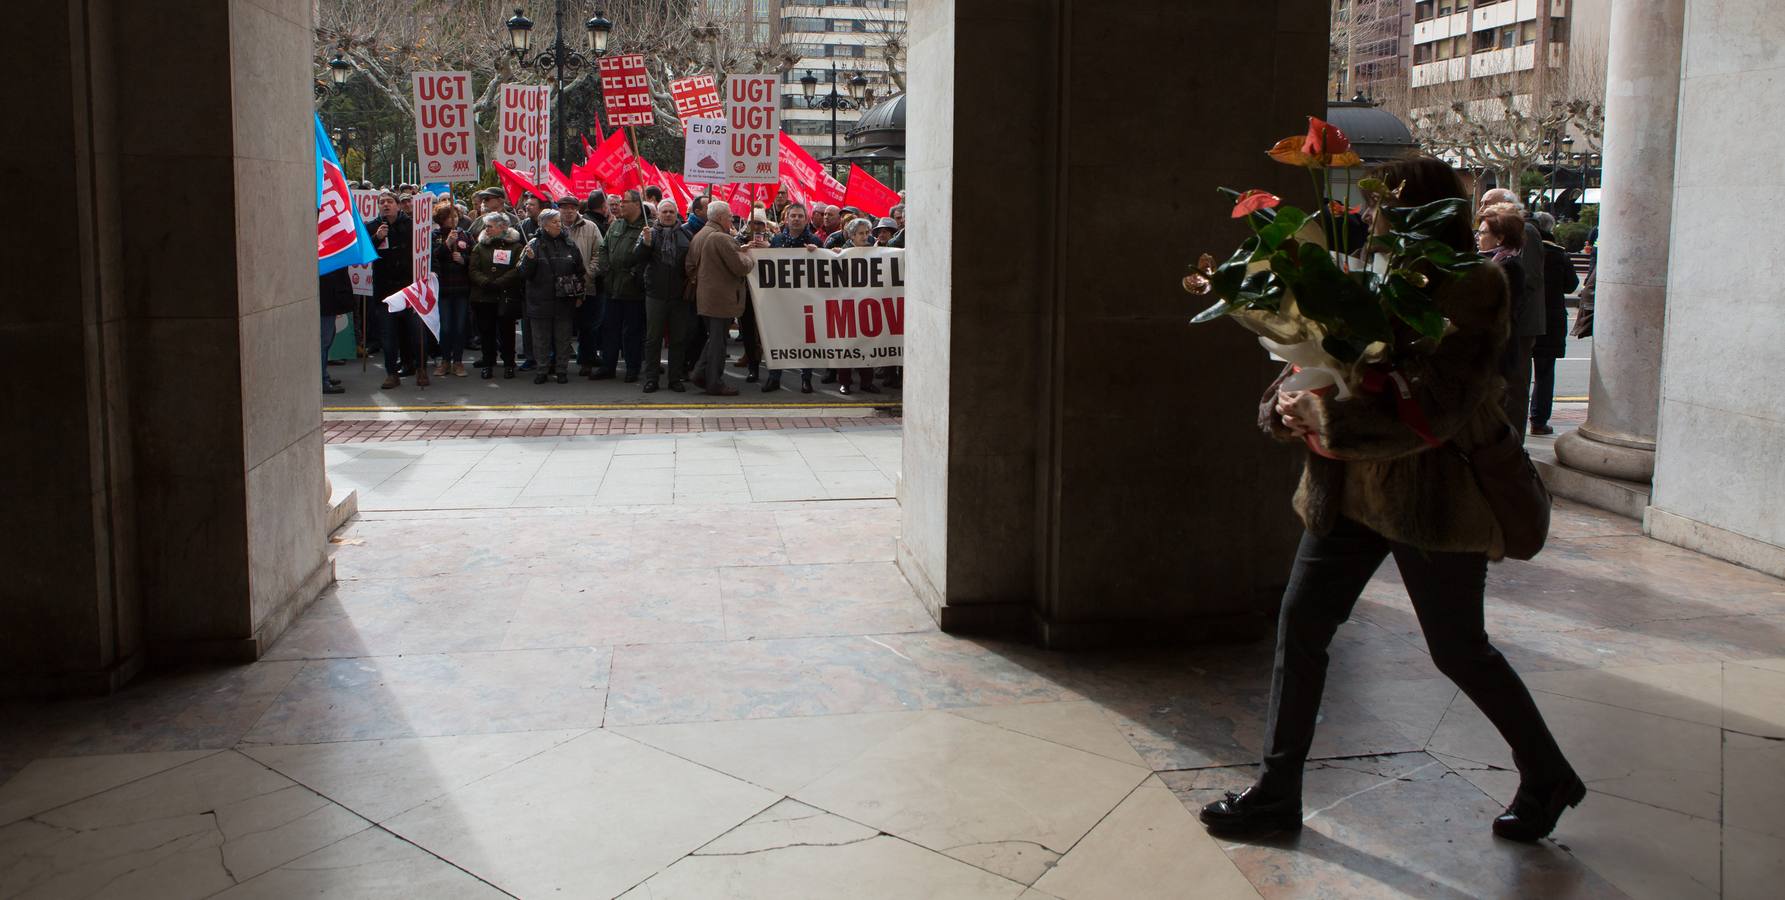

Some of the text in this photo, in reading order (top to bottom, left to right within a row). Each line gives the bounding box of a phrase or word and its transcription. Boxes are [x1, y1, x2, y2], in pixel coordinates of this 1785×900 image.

[418, 76, 466, 101] UGT
[732, 79, 775, 103] UGT
[421, 103, 468, 129] UGT
[731, 106, 775, 130] UGT
[693, 124, 727, 135] El 0,25
[423, 131, 470, 157] UGT
[731, 133, 774, 157] UGT
[415, 197, 431, 224] UGT
[415, 226, 430, 254] UGT
[415, 255, 430, 281] UGT
[757, 257, 884, 289] DEFIENDE
[770, 346, 904, 361] ENSIONISTAS, JUBI
